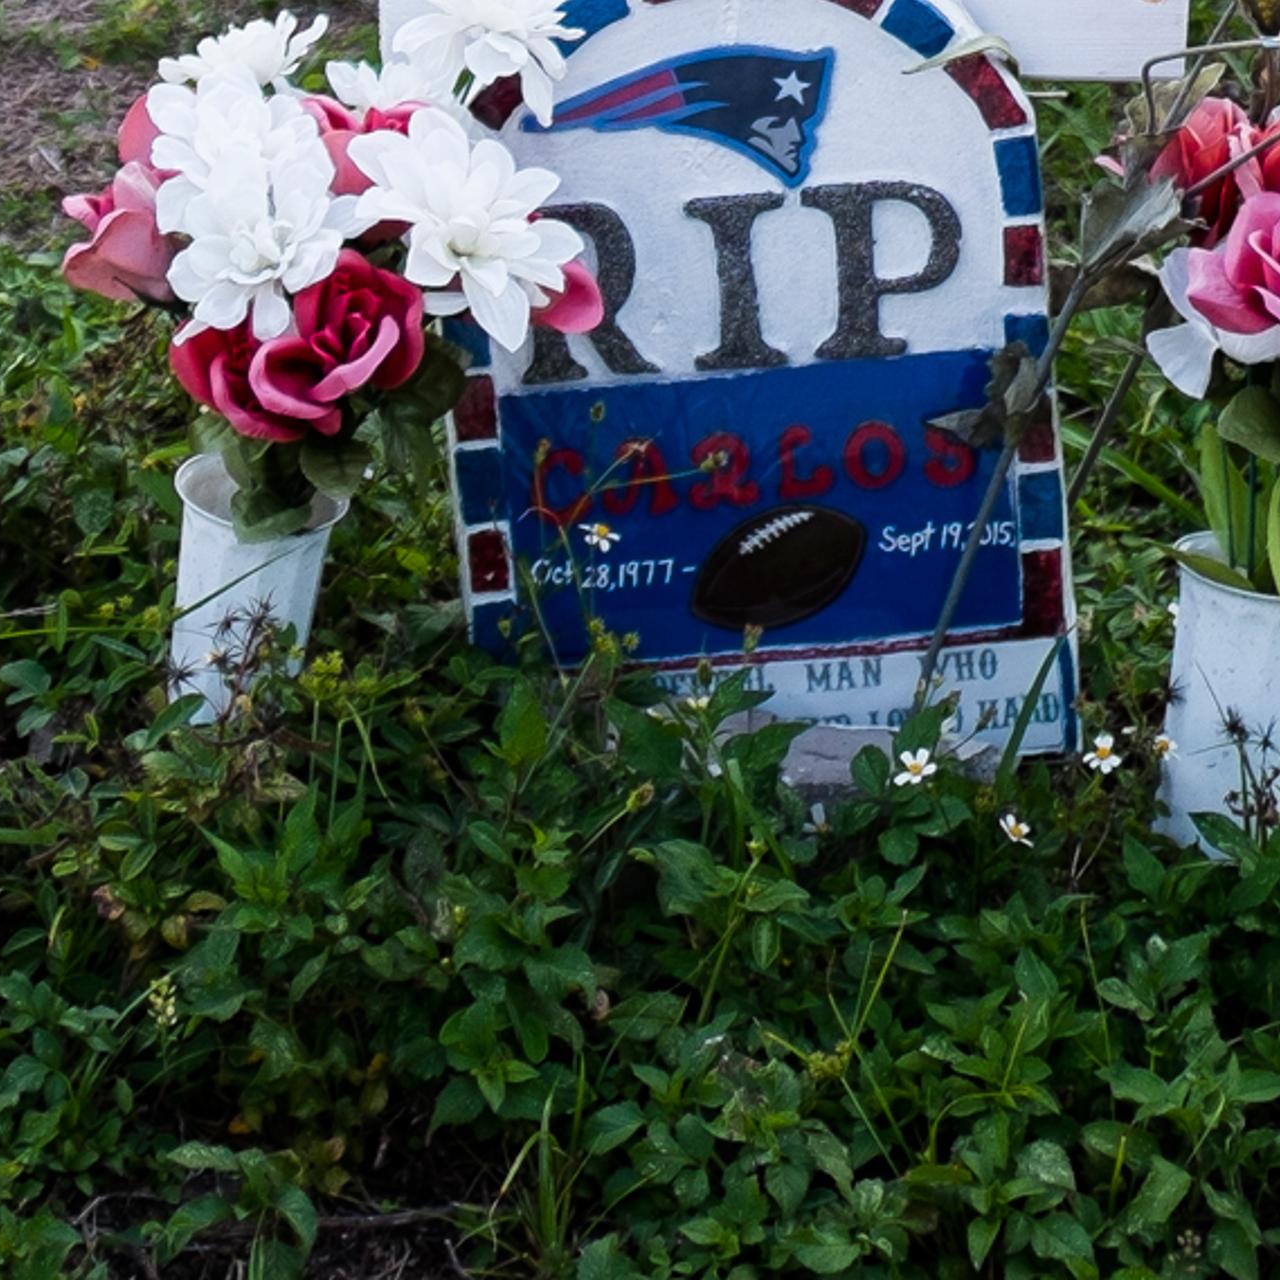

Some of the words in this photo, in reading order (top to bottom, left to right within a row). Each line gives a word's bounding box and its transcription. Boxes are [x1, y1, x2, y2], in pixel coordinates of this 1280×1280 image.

[521, 180, 963, 384] RIP
[530, 421, 978, 524] CARLOS
[531, 558, 574, 586] Oct
[878, 521, 937, 557] Sept
[804, 657, 883, 692] MAN
